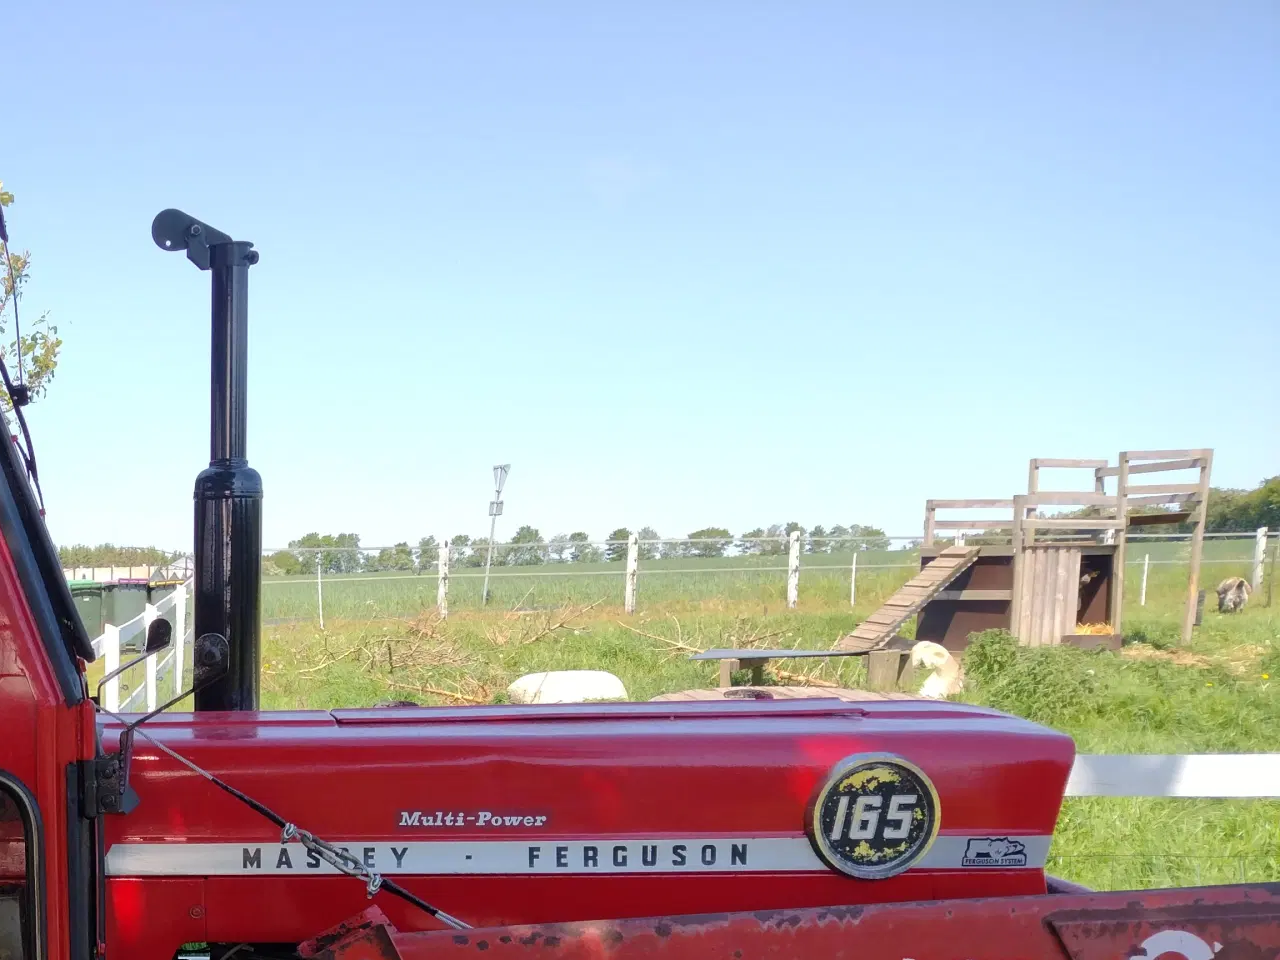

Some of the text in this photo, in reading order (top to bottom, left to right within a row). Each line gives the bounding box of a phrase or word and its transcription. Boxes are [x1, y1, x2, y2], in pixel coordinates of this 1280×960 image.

[399, 811, 547, 827] Multi-Power
[830, 794, 918, 841] 165
[528, 843, 748, 868] FERGUSON
